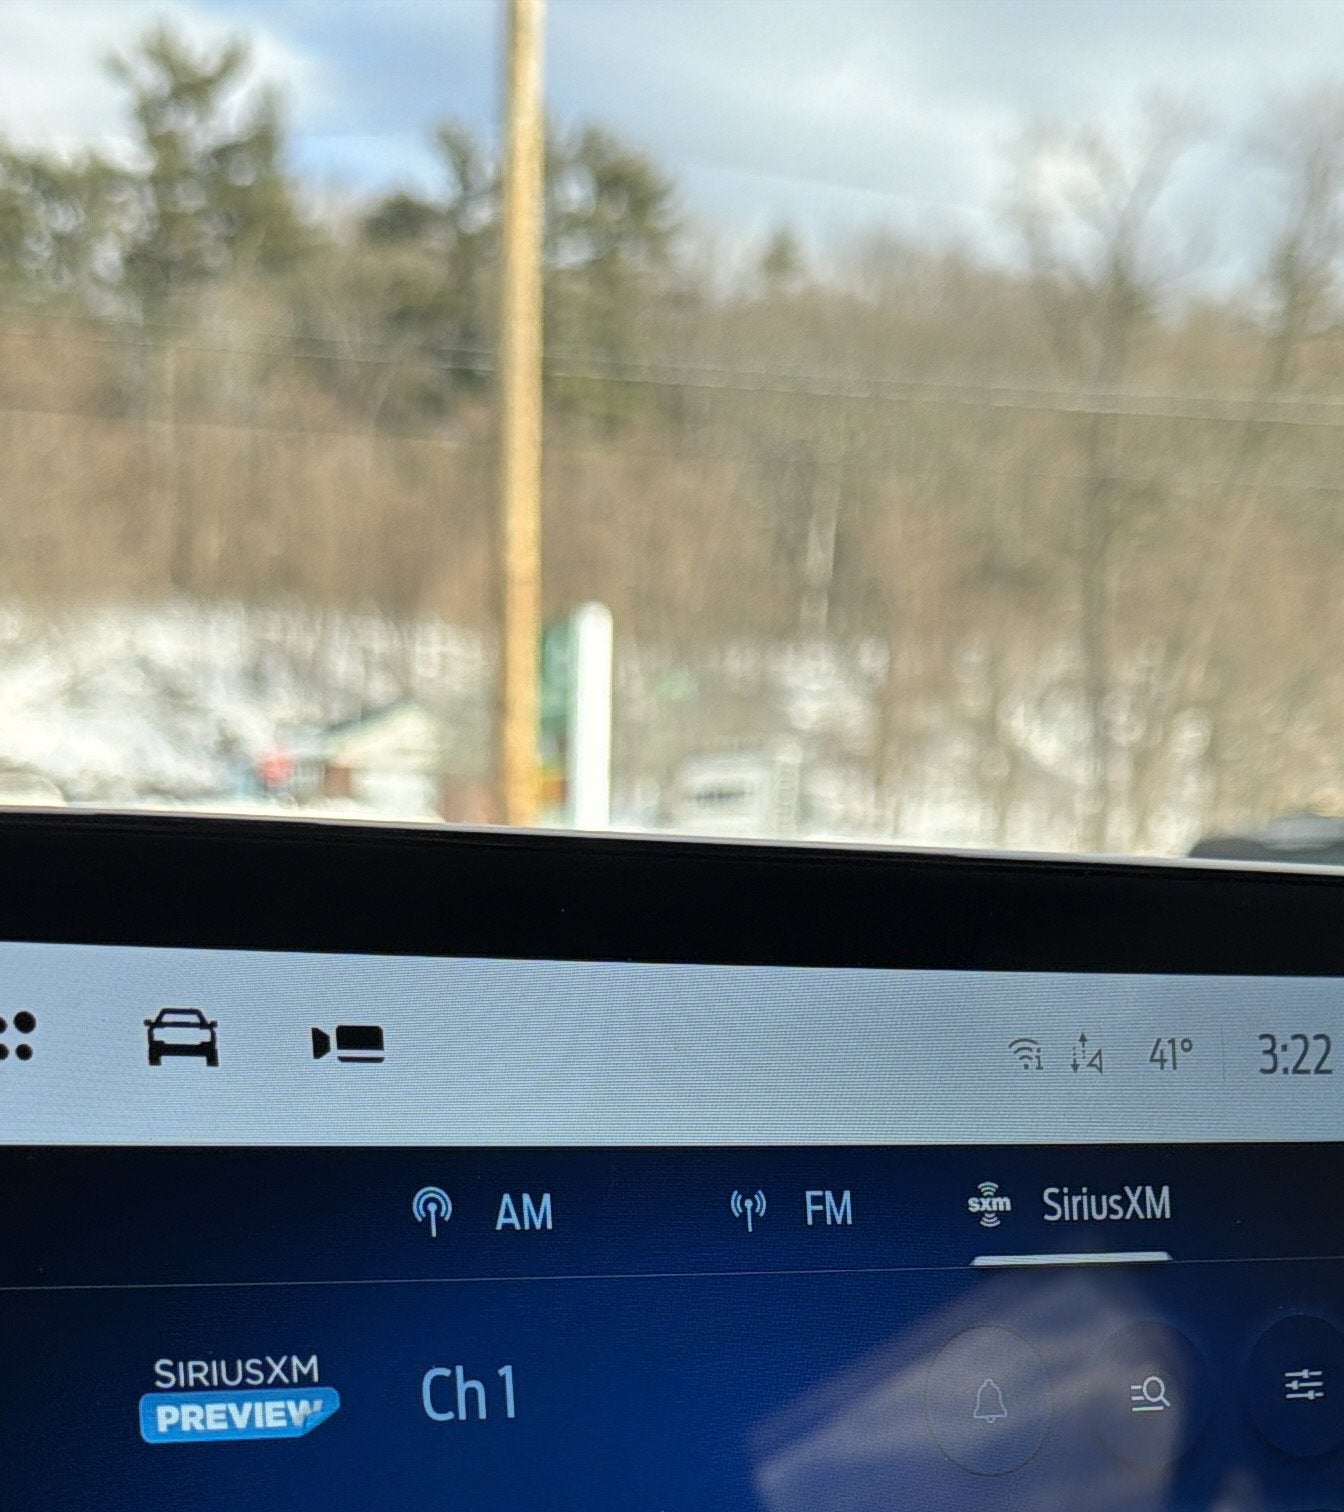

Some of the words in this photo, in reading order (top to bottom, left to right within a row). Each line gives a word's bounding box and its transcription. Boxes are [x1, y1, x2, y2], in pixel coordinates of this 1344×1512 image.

[1258, 1033, 1333, 1075] 3:22
[495, 1191, 553, 1231] AM
[805, 1189, 852, 1226] FM
[967, 1196, 1012, 1213] sxm
[1042, 1185, 1171, 1222] SiriusXM
[154, 1354, 319, 1389] SIRIUSXM
[421, 1365, 487, 1421] Ch
[497, 1364, 516, 1418] 1
[155, 1399, 324, 1433] PREVIEW
